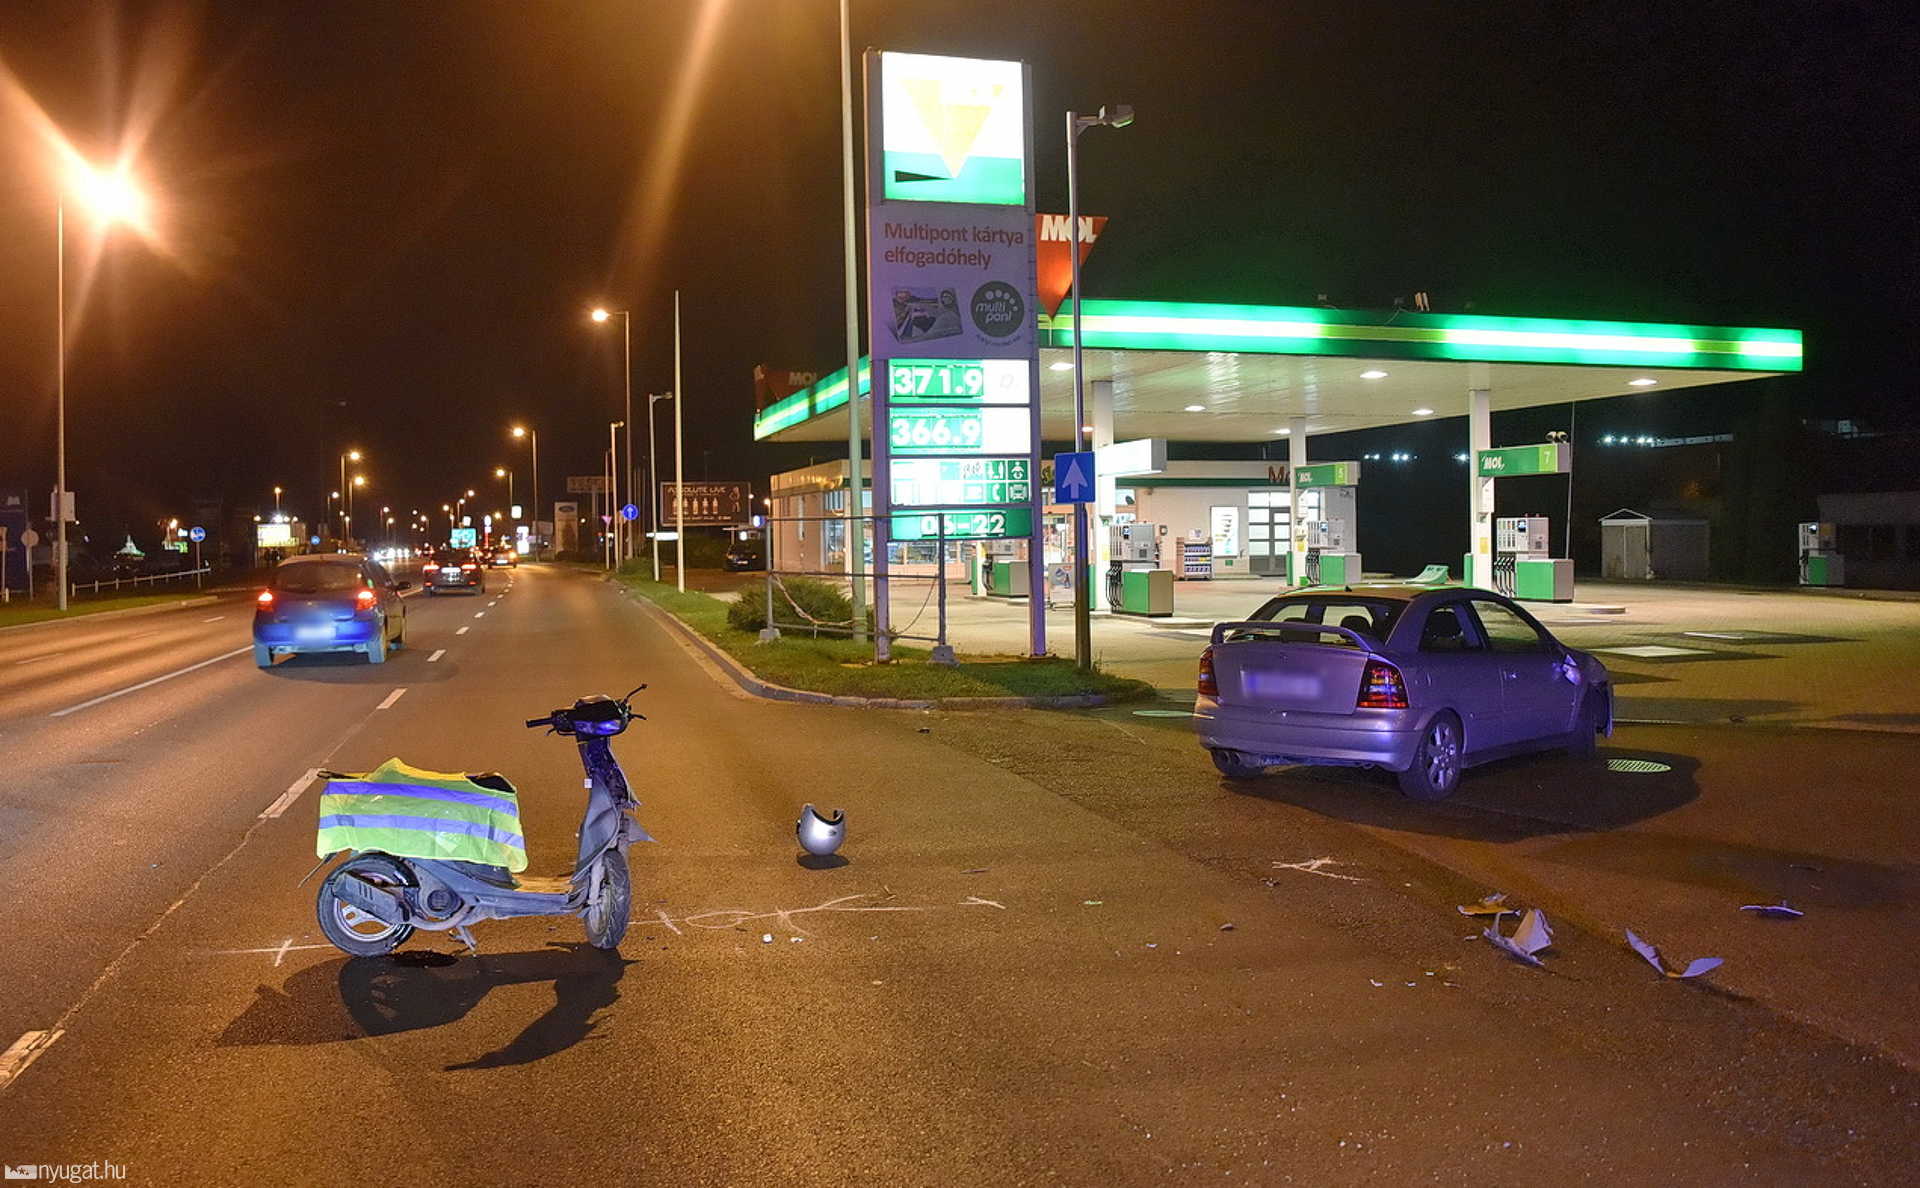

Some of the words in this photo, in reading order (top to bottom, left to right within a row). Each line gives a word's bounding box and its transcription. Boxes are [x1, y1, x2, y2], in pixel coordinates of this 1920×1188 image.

[885, 223, 968, 244] Multipont
[973, 225, 1024, 248] kártya
[1040, 215, 1098, 243] MOL
[885, 246, 991, 270] elfogadóhely
[975, 301, 1006, 312] multi
[985, 310, 1012, 324] pont
[893, 368, 983, 394] 371.9
[892, 418, 981, 446] 366.9
